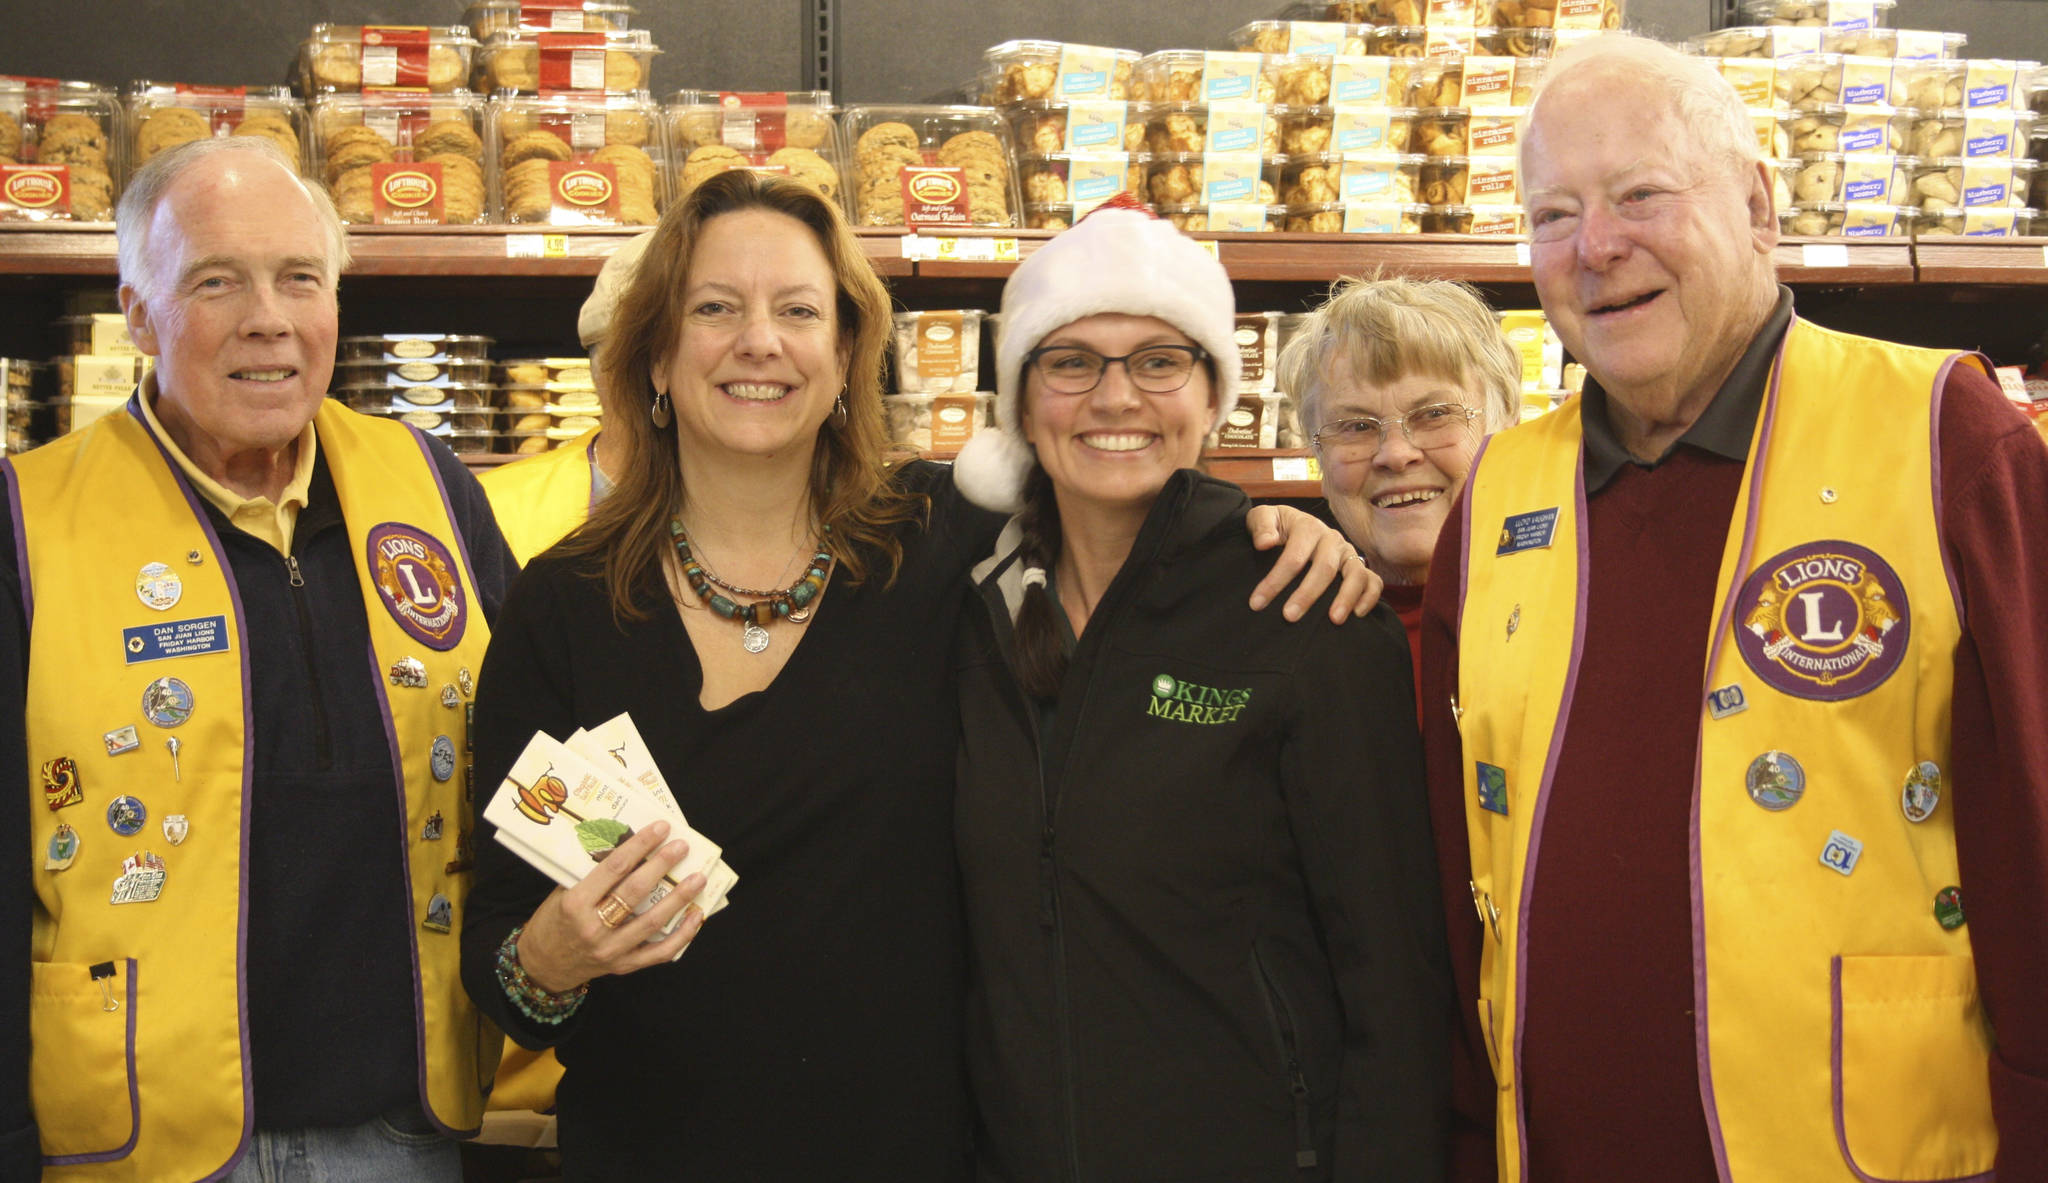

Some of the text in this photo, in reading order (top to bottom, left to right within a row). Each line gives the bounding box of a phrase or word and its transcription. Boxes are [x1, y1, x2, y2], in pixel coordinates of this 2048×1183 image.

[1467, 74, 1508, 84] cinnamon
[1476, 82, 1500, 91] rolls
[1472, 127, 1513, 138] cinnamon
[1483, 135, 1507, 144] rolls
[1472, 174, 1512, 184] cinnamon
[1481, 182, 1504, 191] rolls
[911, 212, 966, 221] Oatmeal Raisin
[1474, 222, 1514, 232] cinnamon
[381, 539, 425, 560] LIONS
[1780, 559, 1858, 587] LIONS
[399, 564, 437, 604] L
[1798, 592, 1844, 641] L
[153, 620, 217, 636] DAN SORGEN
[158, 629, 215, 642] SAN JUAN LIONS
[159, 636, 215, 649] FRIDAY HARBOR
[165, 643, 211, 654] WASHINGTON
[1780, 643, 1870, 671] INTERNATIONAL
[1173, 680, 1253, 705] KINGS
[1708, 685, 1744, 711] 100
[1146, 695, 1246, 724] MARKET
[1768, 764, 1780, 773] 40
